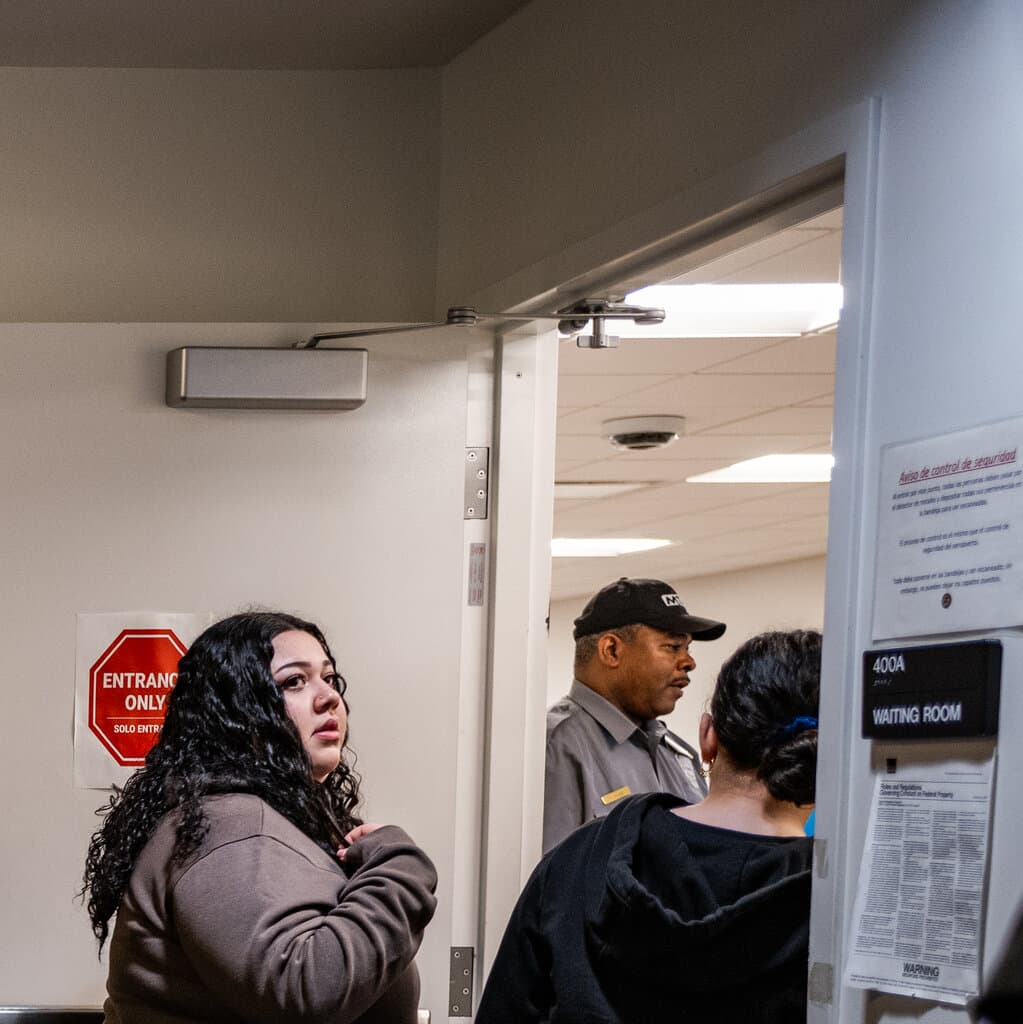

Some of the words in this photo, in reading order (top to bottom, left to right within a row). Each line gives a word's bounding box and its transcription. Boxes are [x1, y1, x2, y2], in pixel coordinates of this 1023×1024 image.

[920, 466, 929, 478] de
[931, 459, 960, 476] control
[962, 458, 971, 470] de
[974, 448, 1017, 468] seguridad
[872, 653, 905, 673] 400A
[102, 672, 179, 689] ENTRANC
[124, 694, 166, 711] ONLY
[872, 706, 920, 725] WAITING
[922, 702, 962, 723] ROOM
[113, 724, 136, 734] SOLO
[903, 962, 940, 977] WARNING
